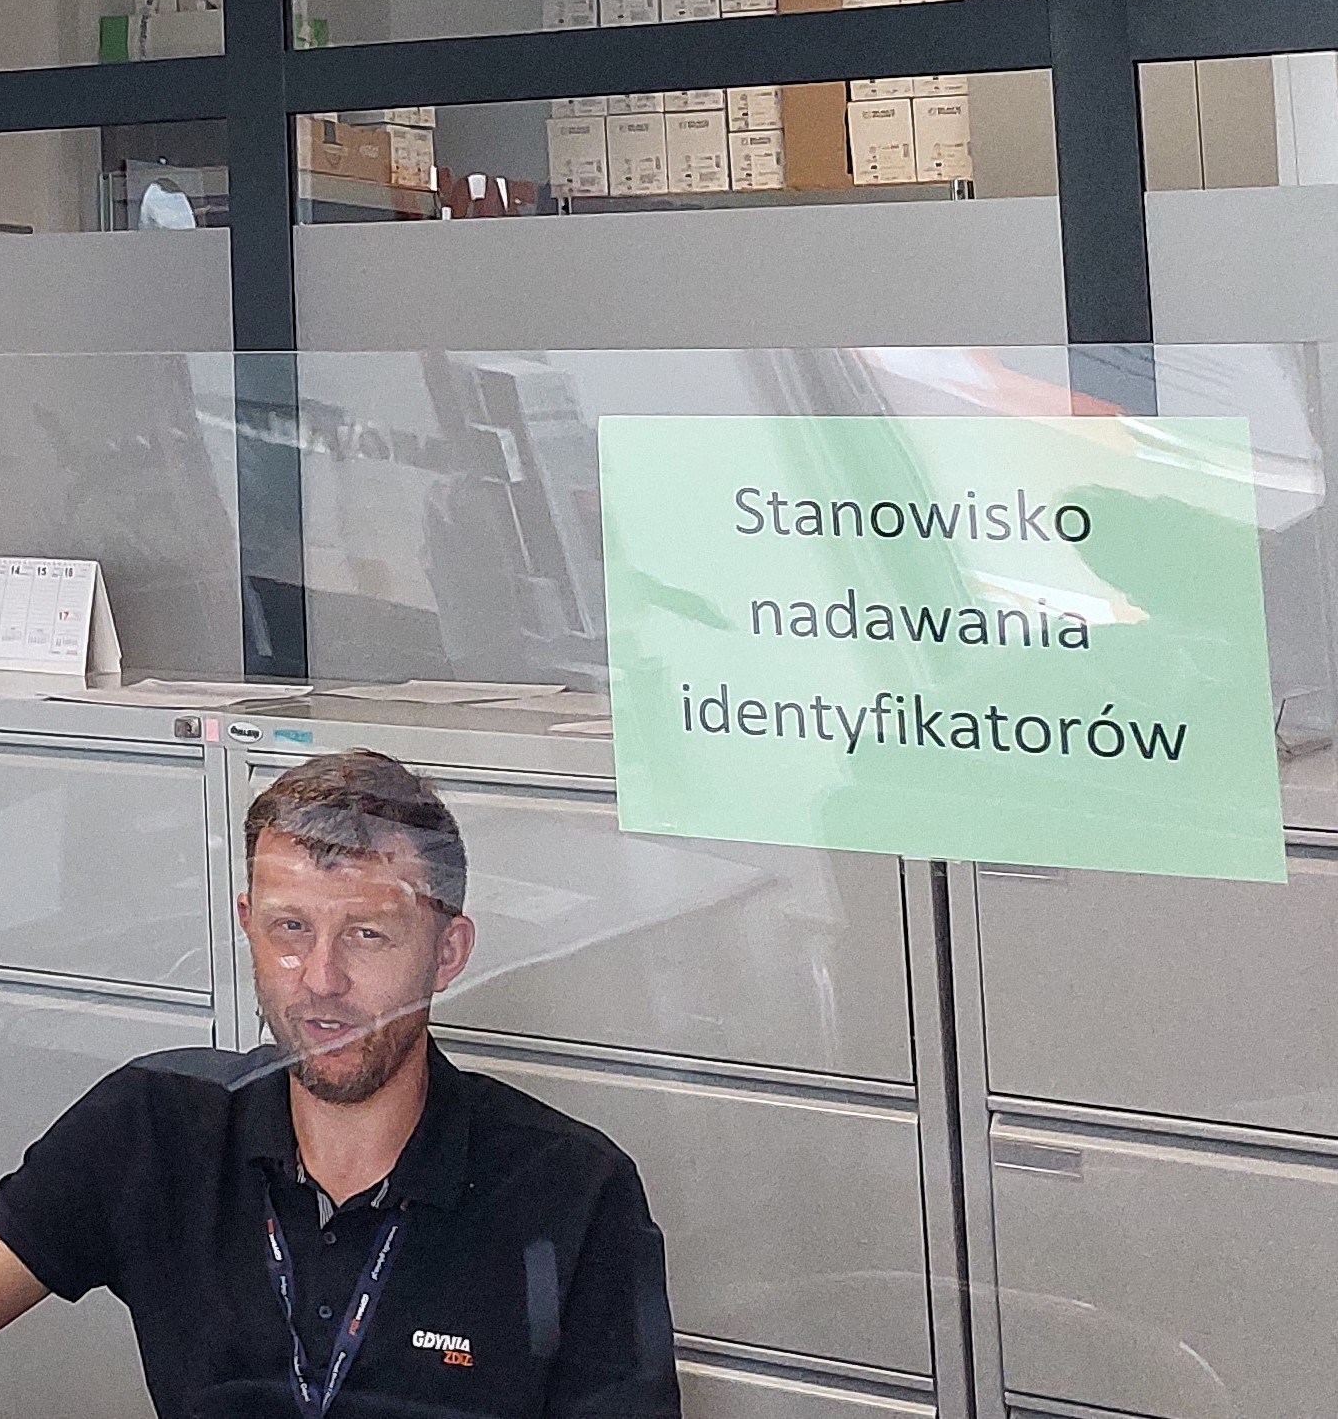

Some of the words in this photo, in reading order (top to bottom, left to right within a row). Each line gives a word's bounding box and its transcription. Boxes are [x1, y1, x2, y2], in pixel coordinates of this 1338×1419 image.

[734, 487, 1092, 542] Stanowisko
[750, 589, 1090, 649] nadawania
[682, 684, 1187, 761] identyfikatorów
[413, 1330, 470, 1352] GDYNIA
